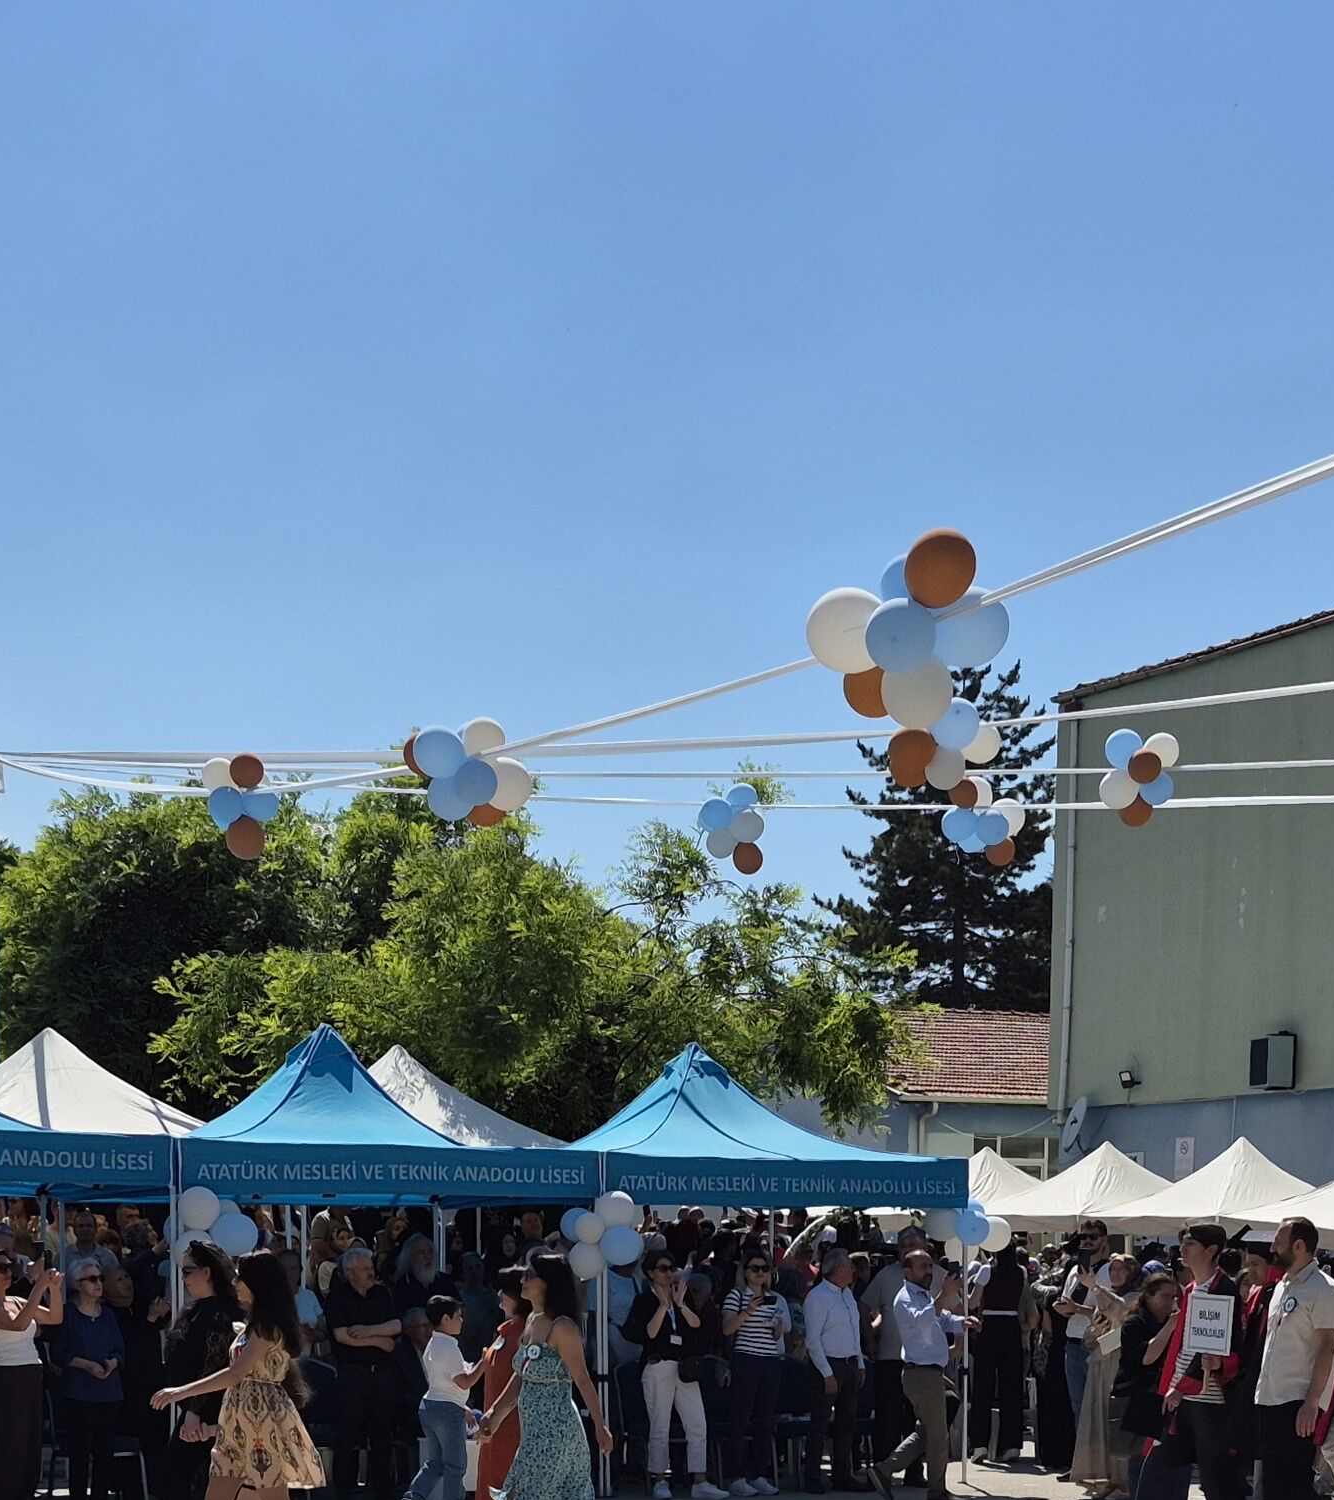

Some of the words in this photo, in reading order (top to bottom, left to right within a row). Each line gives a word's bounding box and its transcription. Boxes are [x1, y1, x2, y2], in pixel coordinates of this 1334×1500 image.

[0, 1149, 95, 1169] ANADOLU
[102, 1149, 154, 1171] LİSESİ
[197, 1160, 278, 1180] ATATÜRK
[283, 1160, 357, 1180] MESLEKİ
[361, 1164, 384, 1180] VE
[388, 1161, 449, 1181] TEKNİK
[453, 1165, 535, 1184] ANADOLU
[540, 1165, 585, 1185] LİSESİ
[618, 1172, 688, 1191] ATATÜRK
[692, 1174, 755, 1192] MESLEKİ
[759, 1177, 779, 1193] VE
[782, 1175, 836, 1193] TEKNİK
[839, 1179, 912, 1194] ANADOLU
[916, 1178, 956, 1195] LİSESİ
